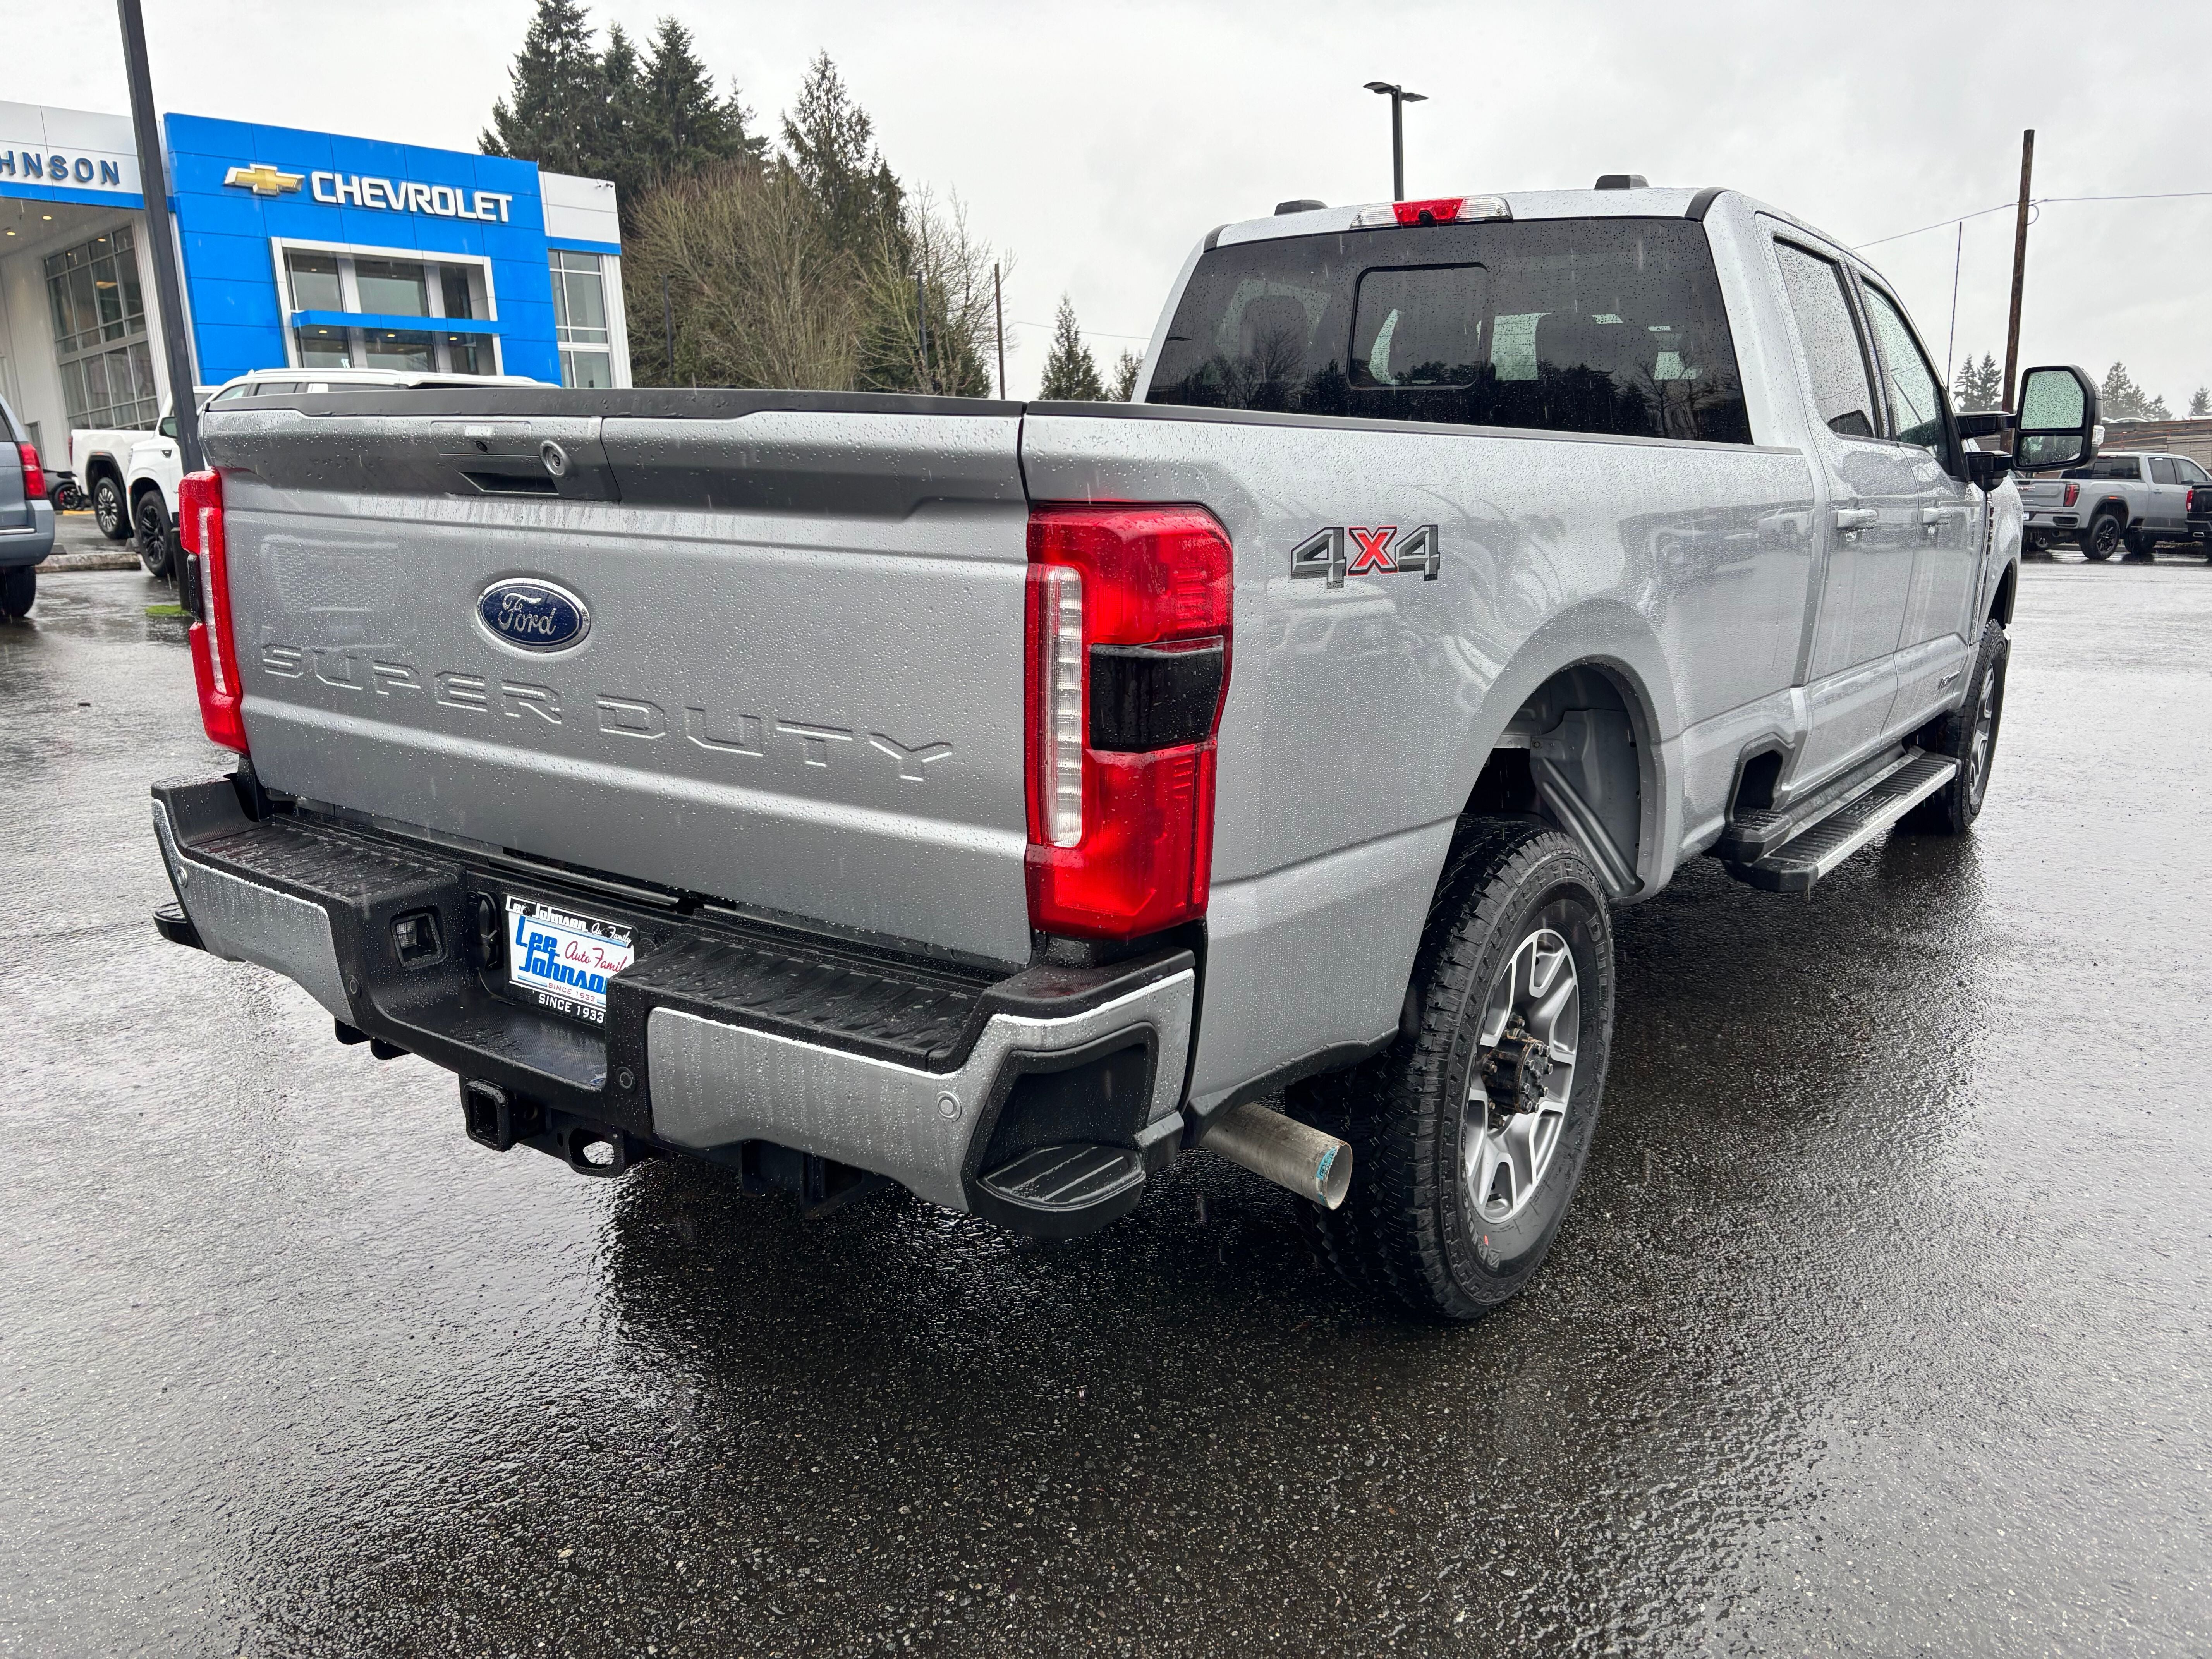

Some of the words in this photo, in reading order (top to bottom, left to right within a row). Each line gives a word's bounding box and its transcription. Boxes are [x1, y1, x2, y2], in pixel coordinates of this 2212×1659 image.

[311, 171, 512, 222] CHEVROLET
[498, 592, 557, 635] Ford
[262, 643, 562, 724] SUPER
[596, 694, 953, 782] DUTY
[515, 915, 560, 955] Lee
[565, 941, 591, 964] Auto
[592, 947, 628, 973] Famil
[532, 903, 589, 932] Johnson
[608, 926, 632, 949] Family
[519, 950, 608, 995] Johnso
[548, 982, 572, 994] SINCE
[576, 991, 595, 1002] 1933
[538, 993, 572, 1013] SINCE
[577, 1005, 605, 1024] 1933
